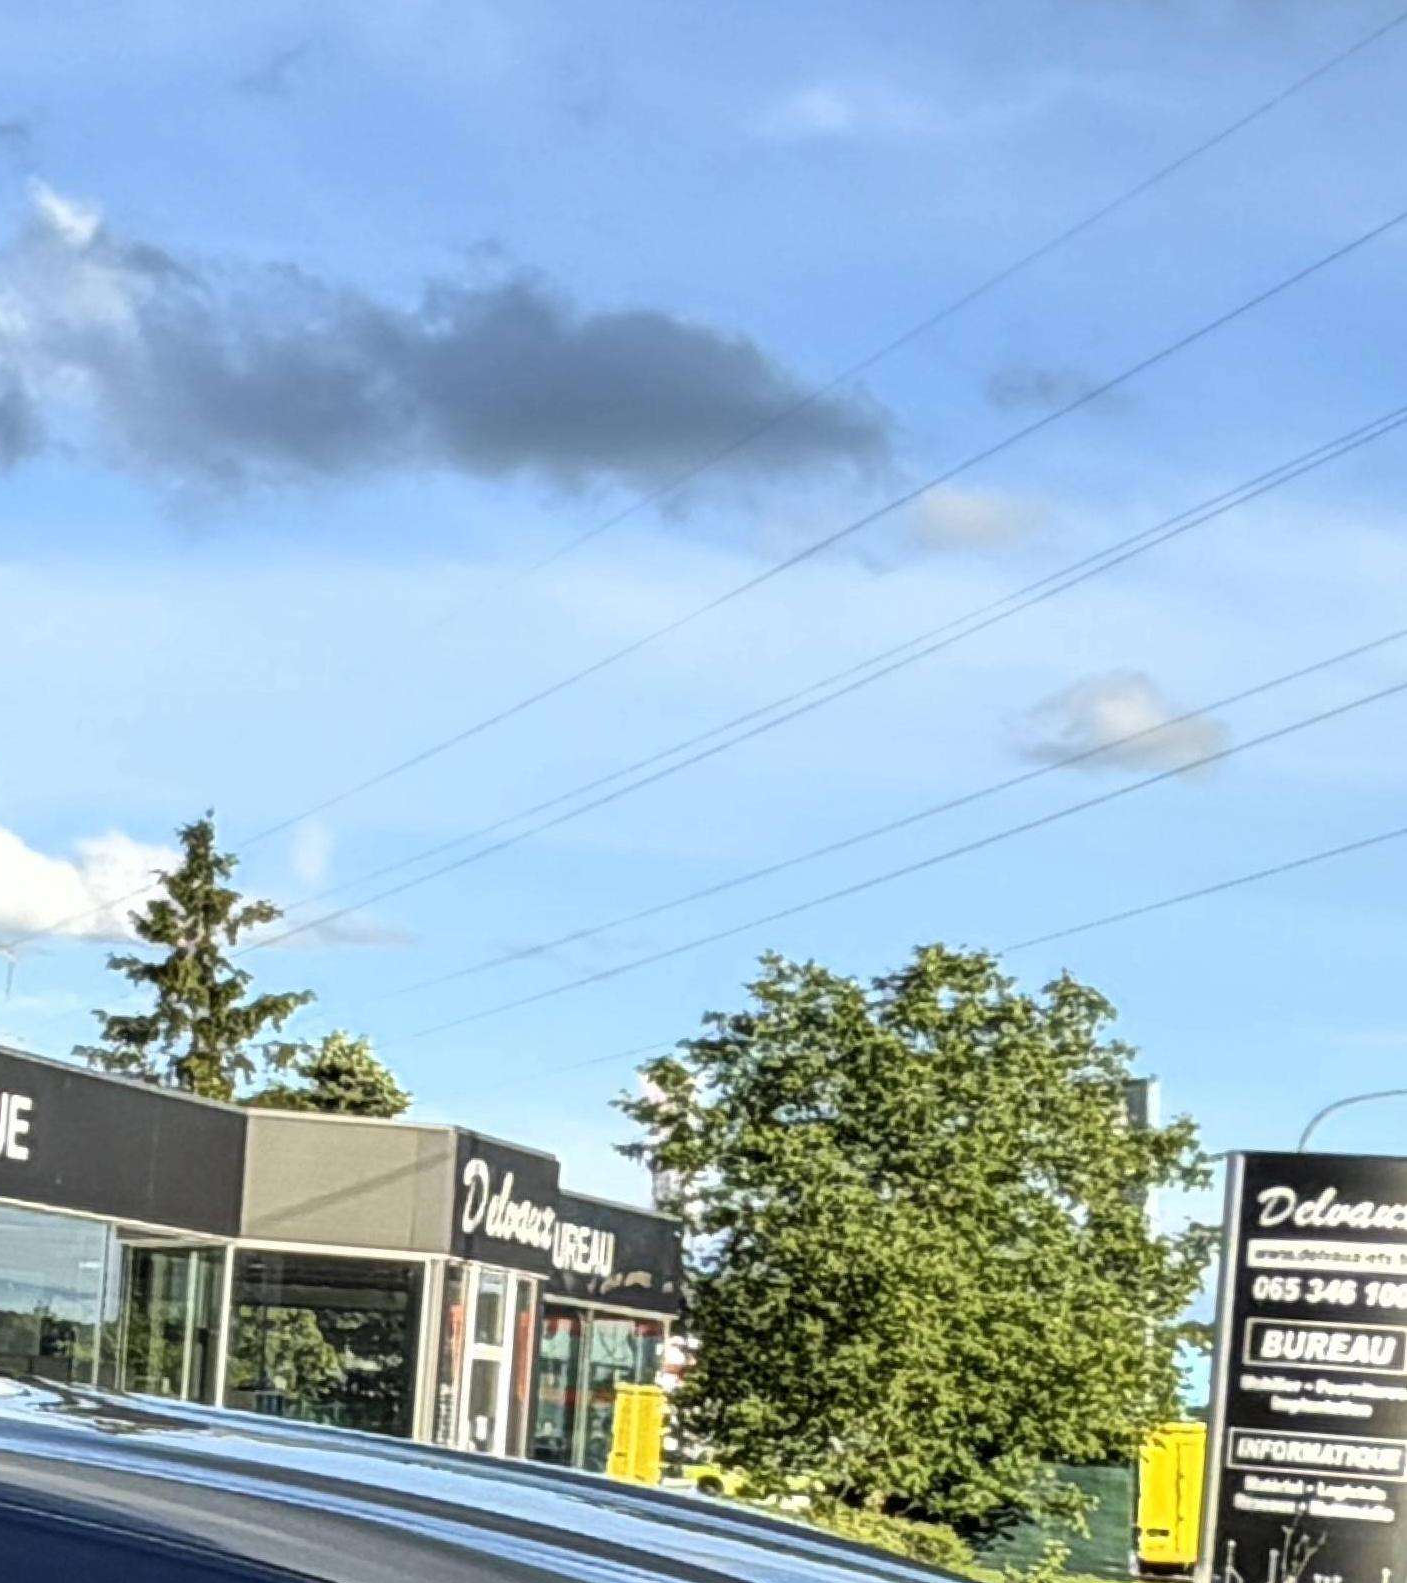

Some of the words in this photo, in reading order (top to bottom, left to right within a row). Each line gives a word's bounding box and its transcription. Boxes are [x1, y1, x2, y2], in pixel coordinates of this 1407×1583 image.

[552, 1221, 616, 1278] UREAU
[1253, 1276, 1301, 1304] 065
[1260, 1329, 1397, 1366] BUREAU
[1237, 1437, 1402, 1471] INFORMATIQUE
